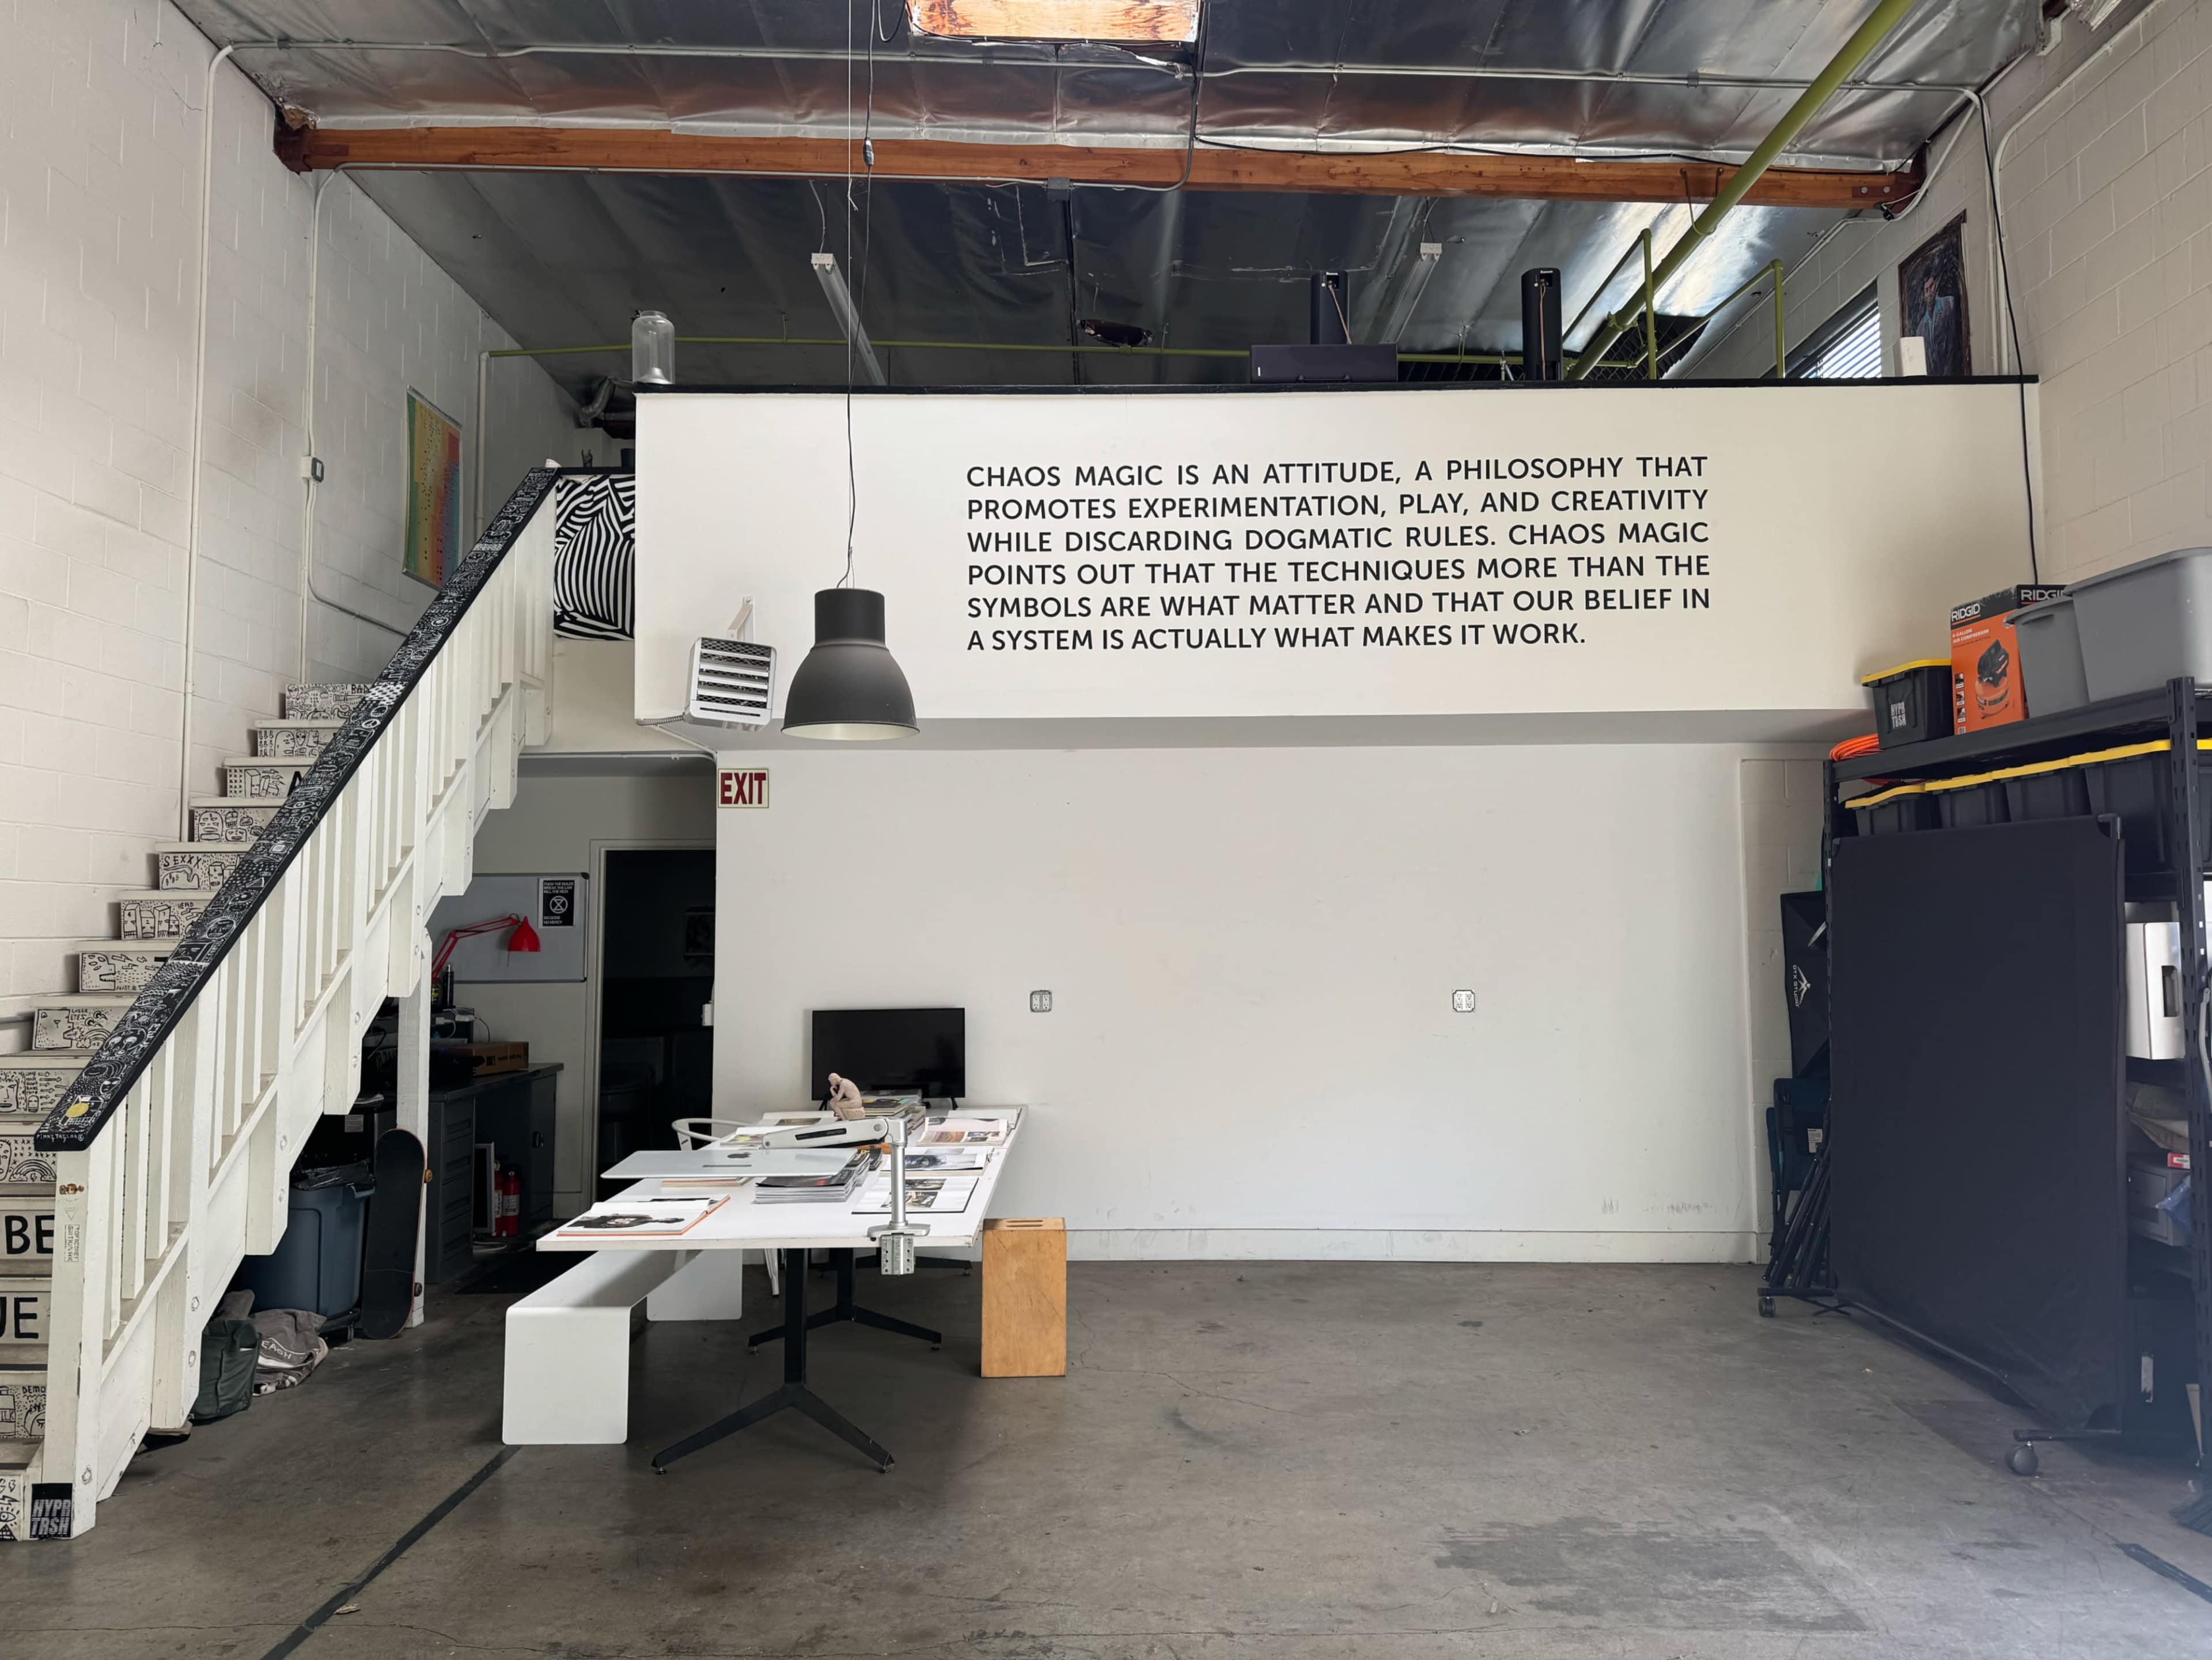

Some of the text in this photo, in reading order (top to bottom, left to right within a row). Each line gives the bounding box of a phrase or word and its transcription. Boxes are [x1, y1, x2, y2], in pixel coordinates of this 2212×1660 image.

[967, 456, 1708, 487] CHAOS MAGIC IS AN ATTITUDE, A PHILOSOPHY THAT
[968, 489, 1708, 520] PROMOTES EXPERIMENTATION, PLAY, AND CREATIVITY
[967, 522, 1709, 552] WHILE DISCARDING DOGMATIC RULES. CHAOS MAGIC
[969, 555, 1710, 585] POINTS OUT THAT THE TECHNIQUES MORE THAN THE
[968, 588, 1709, 618] SYMBOLS ARE WHAT MATTER AND THAT OUR BELIEF IN
[2020, 589, 2065, 601] RIDGI
[1951, 603, 1980, 622] RIDGID
[967, 623, 1585, 651] A SYSTEM IS ACTUALLY WHAT MAKES IT WORK.
[1956, 629, 1972, 637] GALLON
[1960, 628, 1989, 641] COMPRESSOR
[720, 772, 767, 804] EXIT
[163, 854, 202, 869] SEXXX
[5, 1215, 55, 1254] BE
[0, 1411, 14, 1421] ILK
